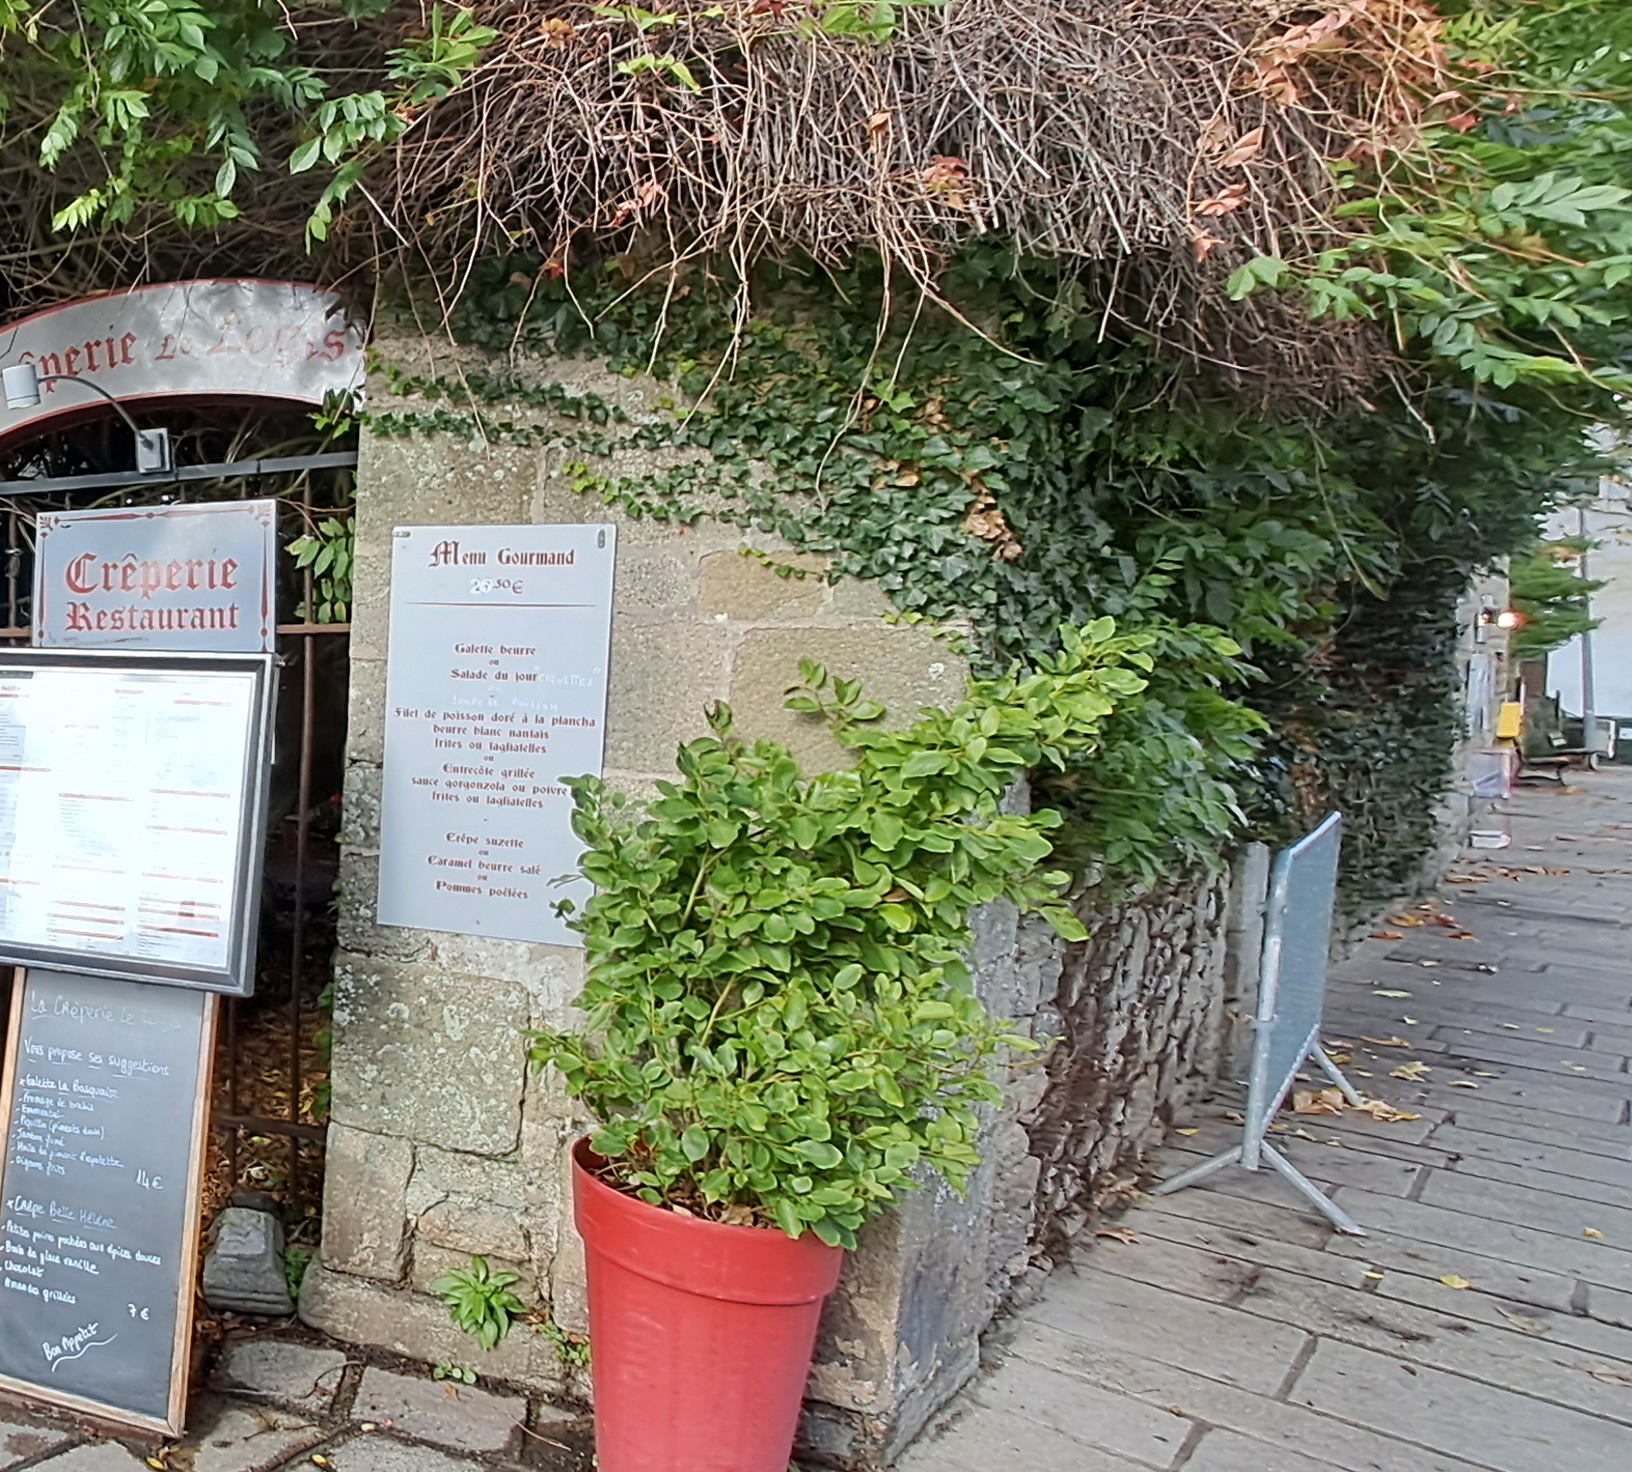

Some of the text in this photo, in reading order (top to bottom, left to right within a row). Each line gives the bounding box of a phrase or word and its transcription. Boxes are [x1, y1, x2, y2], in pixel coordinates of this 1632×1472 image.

[208, 308, 347, 369] Logis
[428, 540, 575, 568] Menu Gourmand
[65, 548, 239, 600] Crêperie
[65, 601, 240, 632] Restaurant
[454, 642, 536, 656] Galette beurre
[488, 658, 499, 666] ou
[450, 668, 488, 680] Salade
[495, 670, 508, 681] du
[393, 707, 596, 727] Filet de poisson doré à la plancha
[433, 724, 550, 740] beurre blanc nantais
[434, 737, 547, 754] frites ou tagliatelles
[442, 763, 535, 779] Entrecôte grillée
[411, 775, 568, 796] sauce gorgonzola ou poivre
[432, 791, 544, 809] frites ou tagliatelles
[445, 831, 524, 848] Crêpe suzette
[427, 855, 541, 876] Caramel beurre salé
[435, 880, 529, 900] Pommes poêlées
[31, 990, 48, 1013] La
[48, 1045, 84, 1063] propose
[88, 1051, 104, 1064] ses
[108, 1053, 170, 1078] suggestions
[26, 1073, 57, 1089] Galette
[58, 1079, 70, 1092] La
[23, 1090, 94, 1112] Fromage de brebis
[17, 1127, 43, 1142] Jambon
[38, 1144, 48, 1156] de
[50, 1200, 76, 1220] Belle
[89, 1241, 104, 1253] aux
[4, 1260, 46, 1278] Chocolat
[27, 1246, 37, 1258] de
[63, 1256, 100, 1275] vanille
[4, 1277, 40, 1296] Amandes
[42, 1341, 62, 1361] Bon
